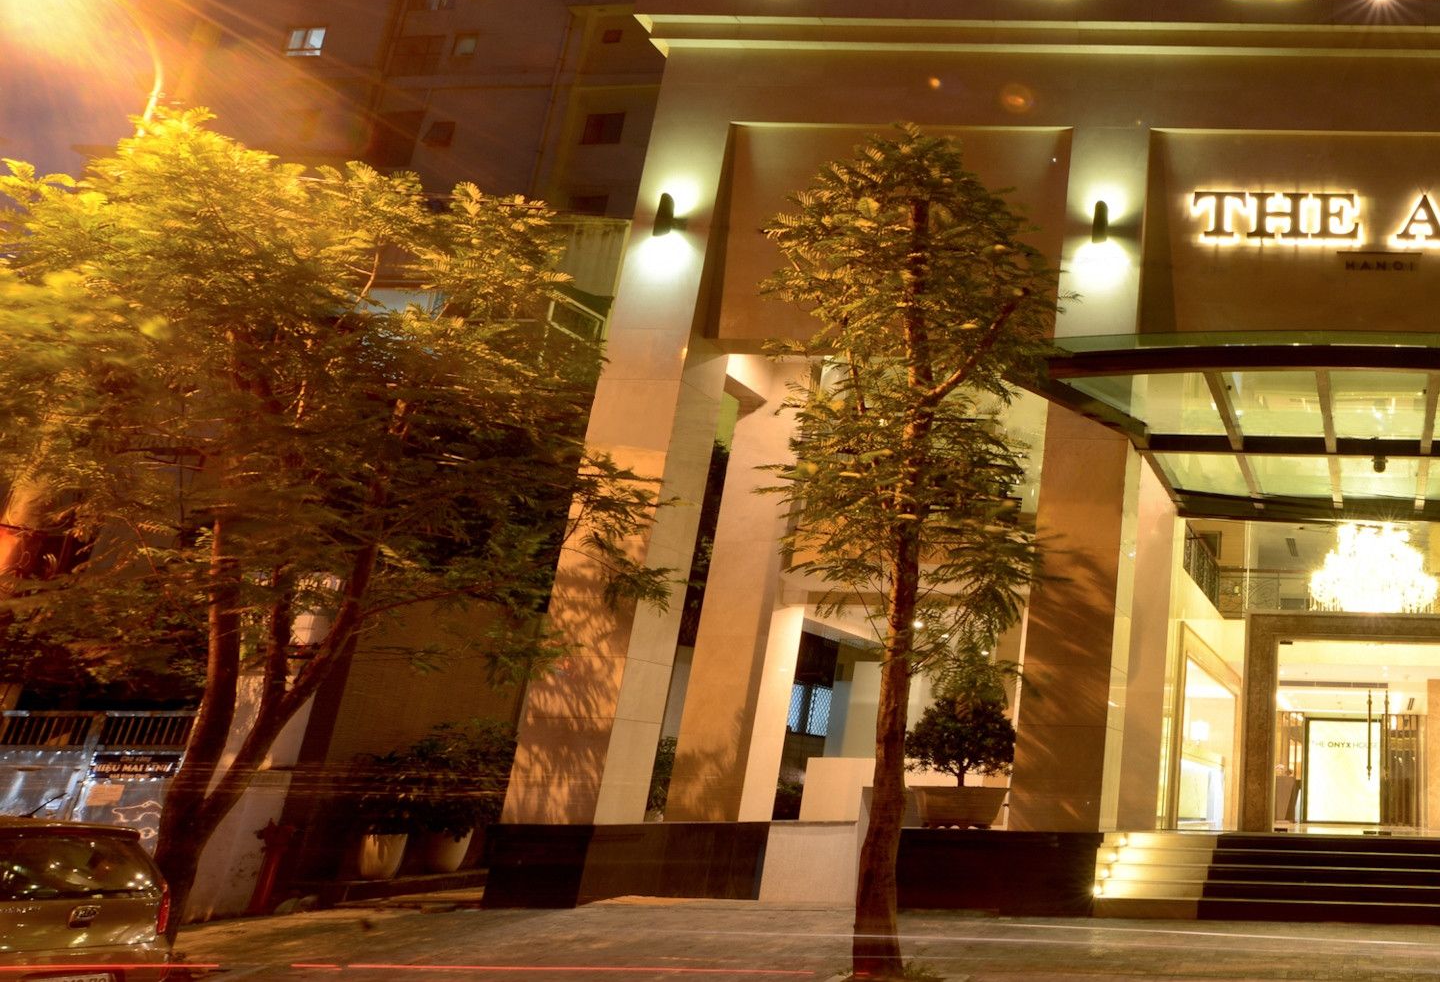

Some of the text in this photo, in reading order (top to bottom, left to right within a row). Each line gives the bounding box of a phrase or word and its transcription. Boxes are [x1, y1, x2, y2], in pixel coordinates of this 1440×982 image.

[1192, 191, 1360, 241] THE
[1344, 260, 1414, 272] HANOI
[1327, 740, 1353, 749] ONYX
